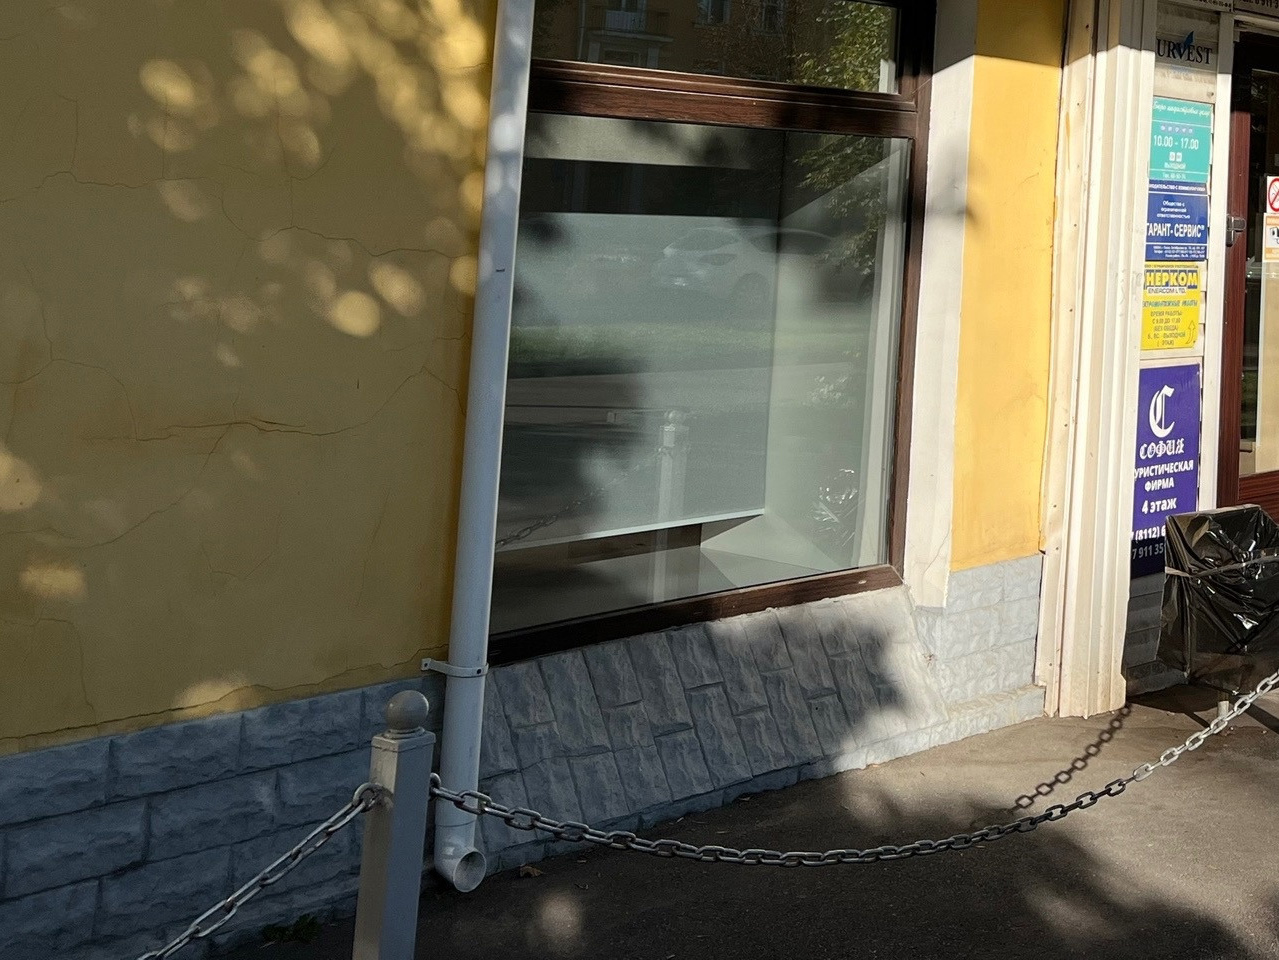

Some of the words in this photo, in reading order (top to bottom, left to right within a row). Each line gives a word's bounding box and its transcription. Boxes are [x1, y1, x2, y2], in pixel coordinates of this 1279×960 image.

[1153, 135, 1173, 148] 10.00
[1180, 137, 1199, 150] 17.00
[1145, 271, 1198, 287] НЕРКОМ
[1134, 460, 1194, 481] УРИСТИЧЕСКАЯ
[1144, 477, 1174, 492] ФИРМА
[1141, 500, 1149, 514] 4
[1149, 497, 1177, 514] этаж
[1135, 526, 1160, 542] (8112)
[1138, 545, 1153, 559] 911
